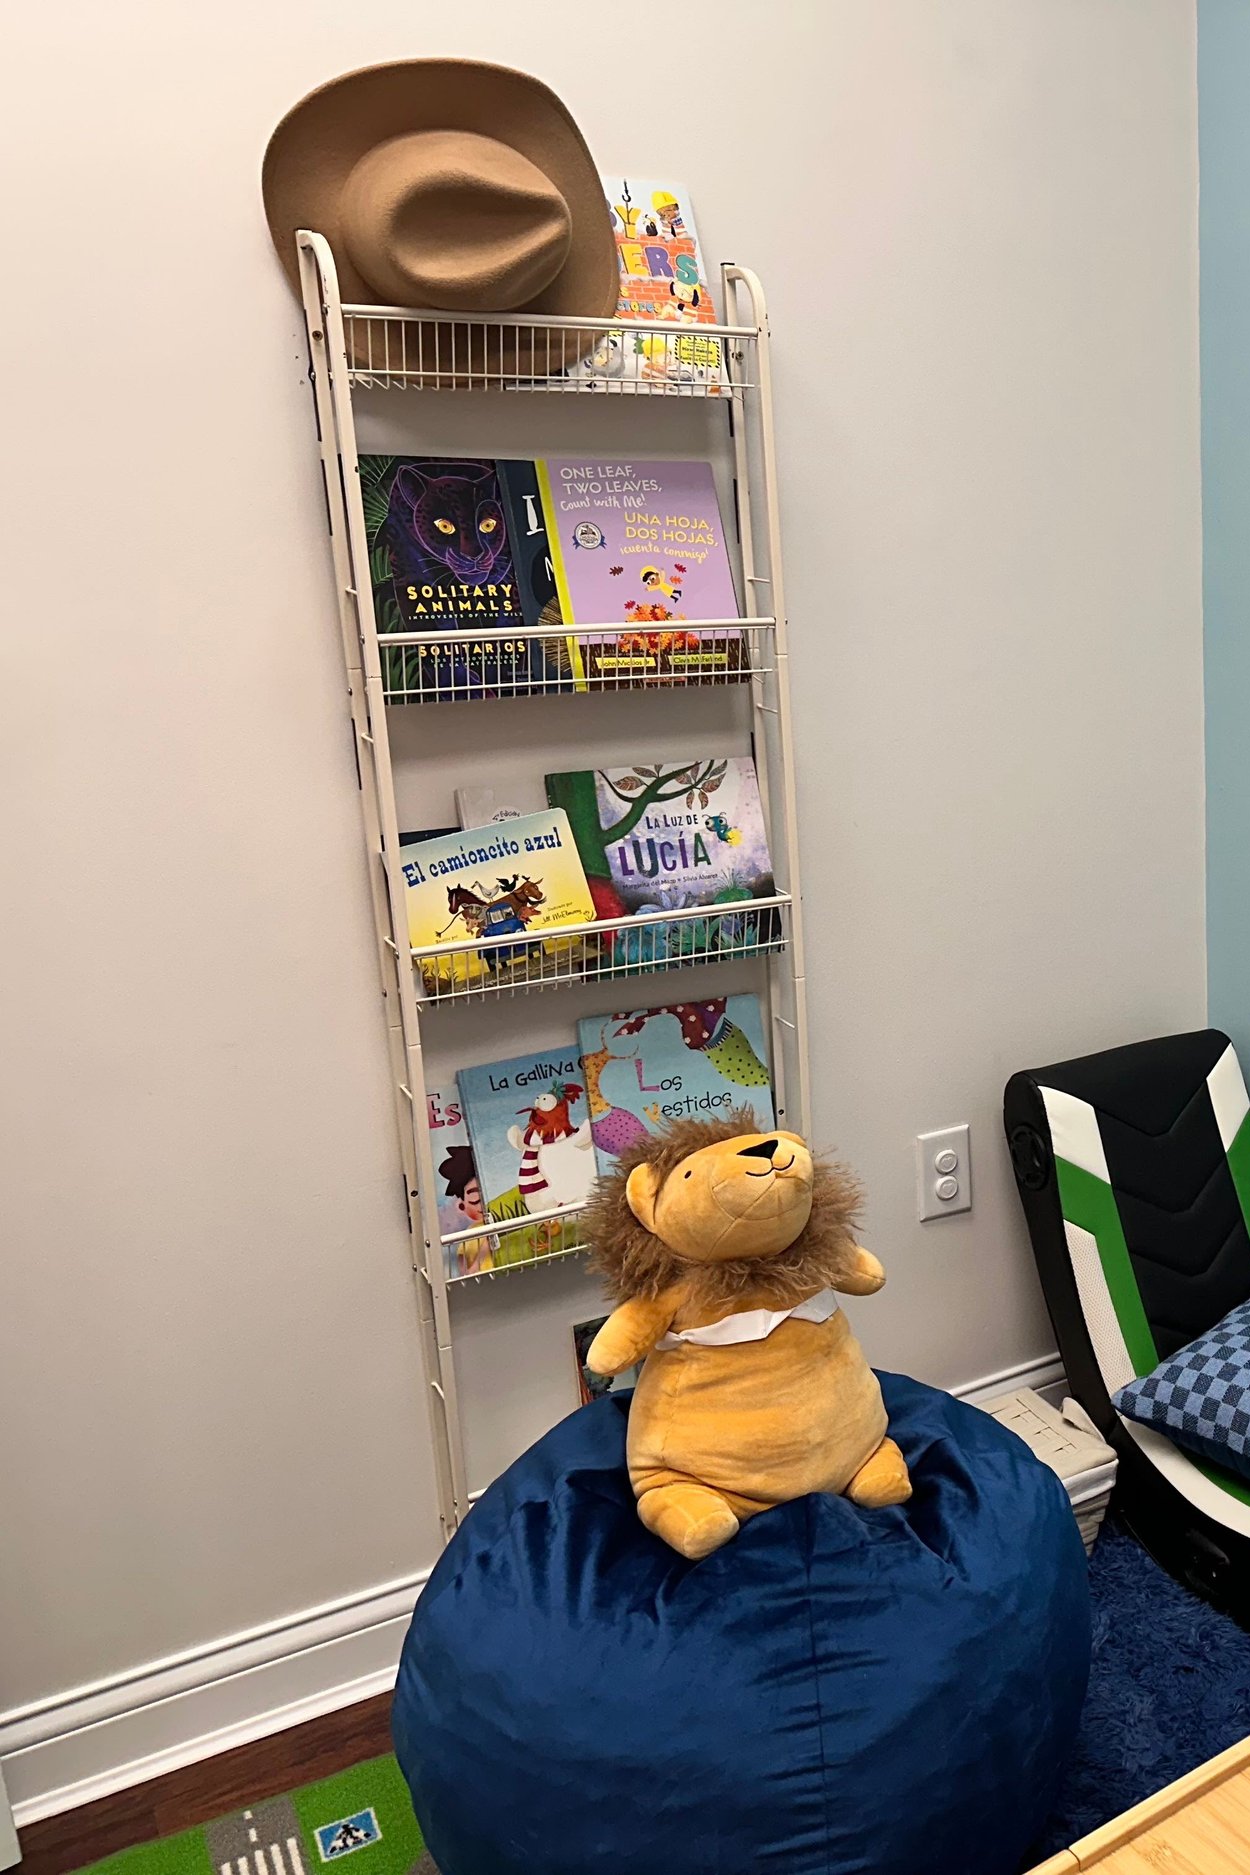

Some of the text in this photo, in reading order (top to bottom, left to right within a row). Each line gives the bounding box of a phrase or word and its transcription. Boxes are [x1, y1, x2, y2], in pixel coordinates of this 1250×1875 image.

[617, 243, 700, 286] ERS
[560, 465, 636, 479] ONE LEAF,
[562, 479, 662, 495] TWO LEAVES,
[560, 493, 647, 511] Count with Me!
[624, 511, 714, 532] UNA HOJA,
[626, 526, 718, 548] DOS HOJAS,
[406, 584, 512, 600] SOLITARY
[415, 600, 513, 613] ANIMALS
[420, 641, 526, 658] SOLITAROS
[402, 826, 562, 888] El camioncito azul
[617, 831, 712, 878] LUCÍA
[489, 1075, 509, 1092] La
[634, 1058, 683, 1092] Los
